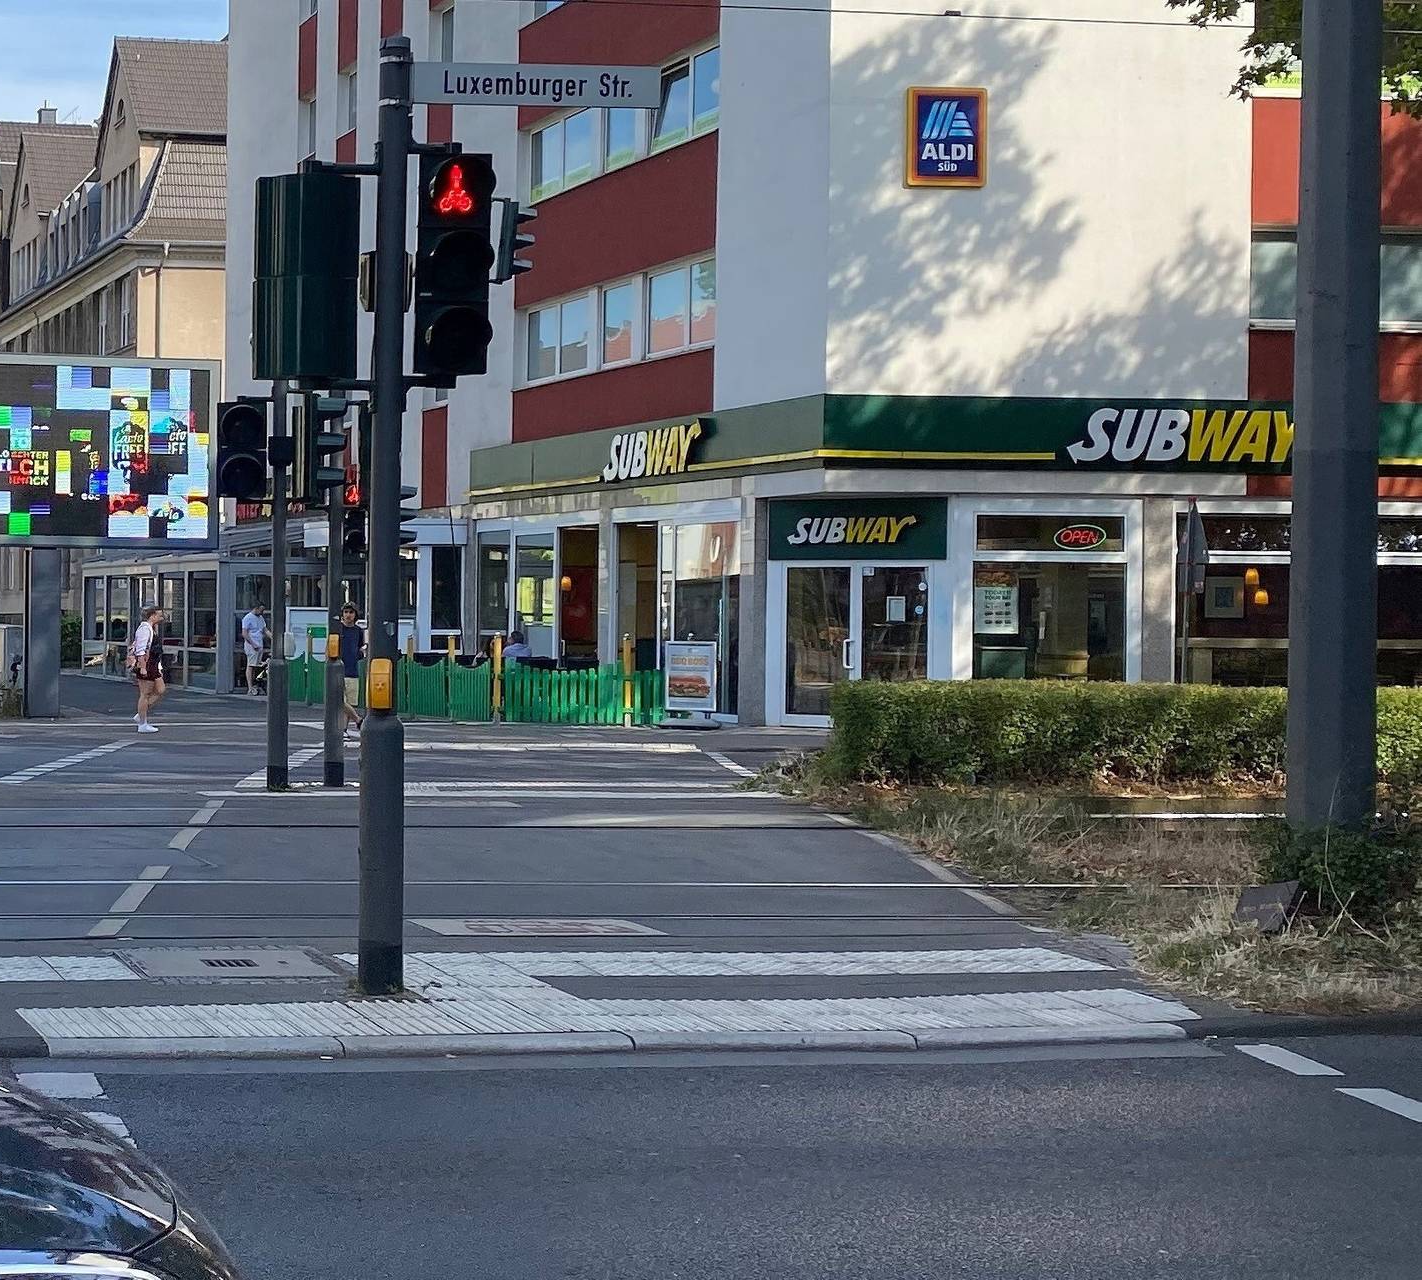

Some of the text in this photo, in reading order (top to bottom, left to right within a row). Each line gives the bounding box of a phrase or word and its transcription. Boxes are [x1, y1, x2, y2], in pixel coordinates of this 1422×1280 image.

[443, 70, 633, 102] Luxemburger Str.
[921, 142, 975, 161] ALDI
[937, 160, 958, 172] SÜD
[603, 418, 703, 483] SUBWAY
[1066, 407, 1295, 465] SUBWAY
[787, 515, 917, 546] SUBWAY
[1060, 530, 1099, 544] OPEN
